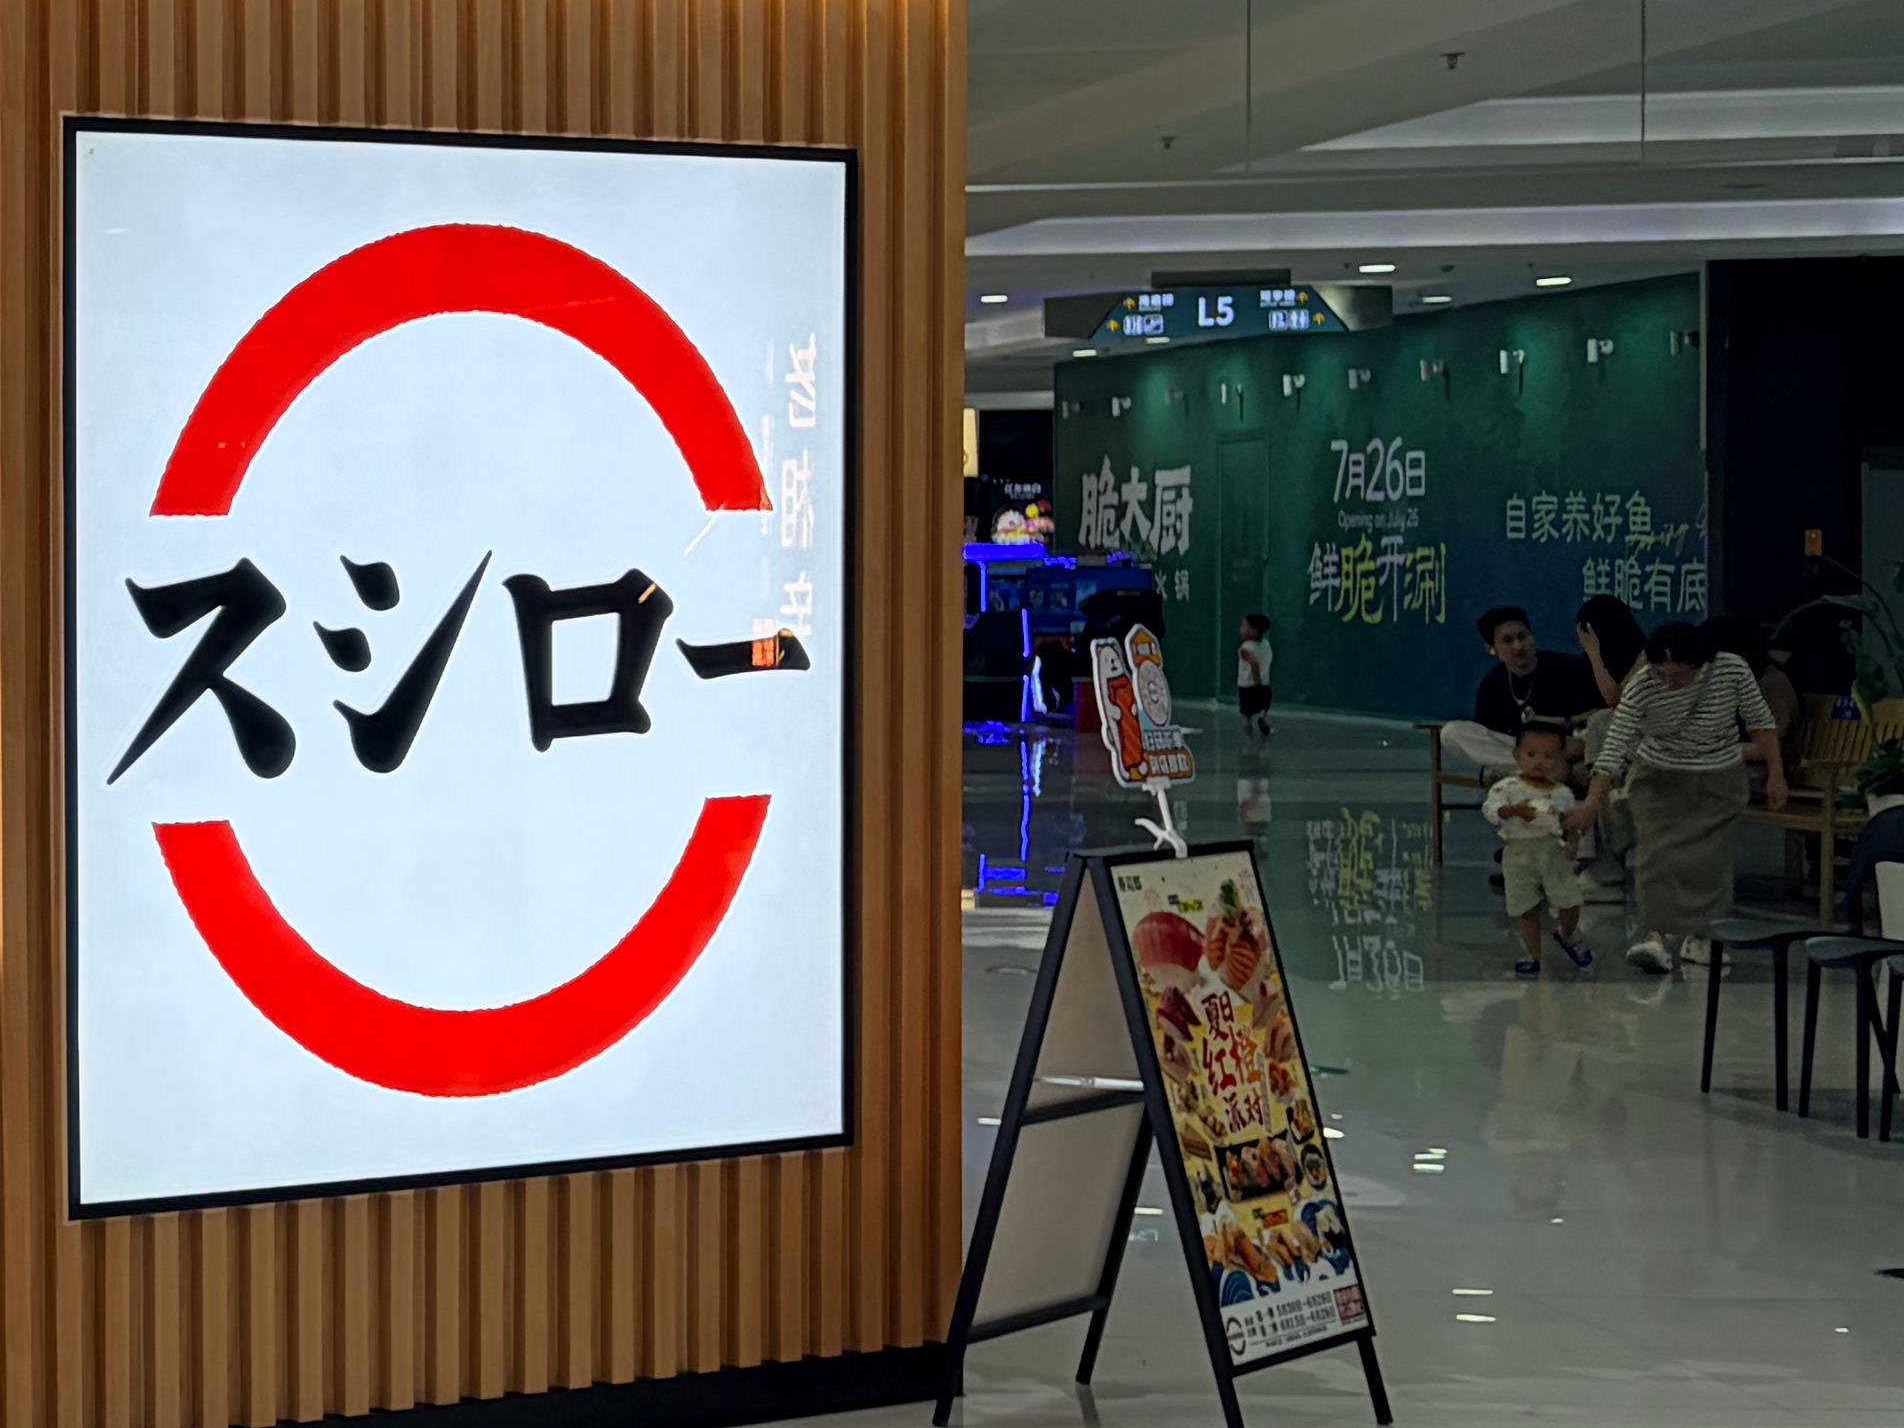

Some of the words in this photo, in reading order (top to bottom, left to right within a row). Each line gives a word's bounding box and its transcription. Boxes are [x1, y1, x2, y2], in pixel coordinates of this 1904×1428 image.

[1199, 296, 1234, 327] L5
[1079, 454, 1193, 557] 脆大厨
[1330, 436, 1425, 504] 7月26日
[1505, 490, 1652, 544] 自家养好鱼
[1307, 533, 1446, 625] 鲜脆开涮
[106, 551, 810, 784] スシロー
